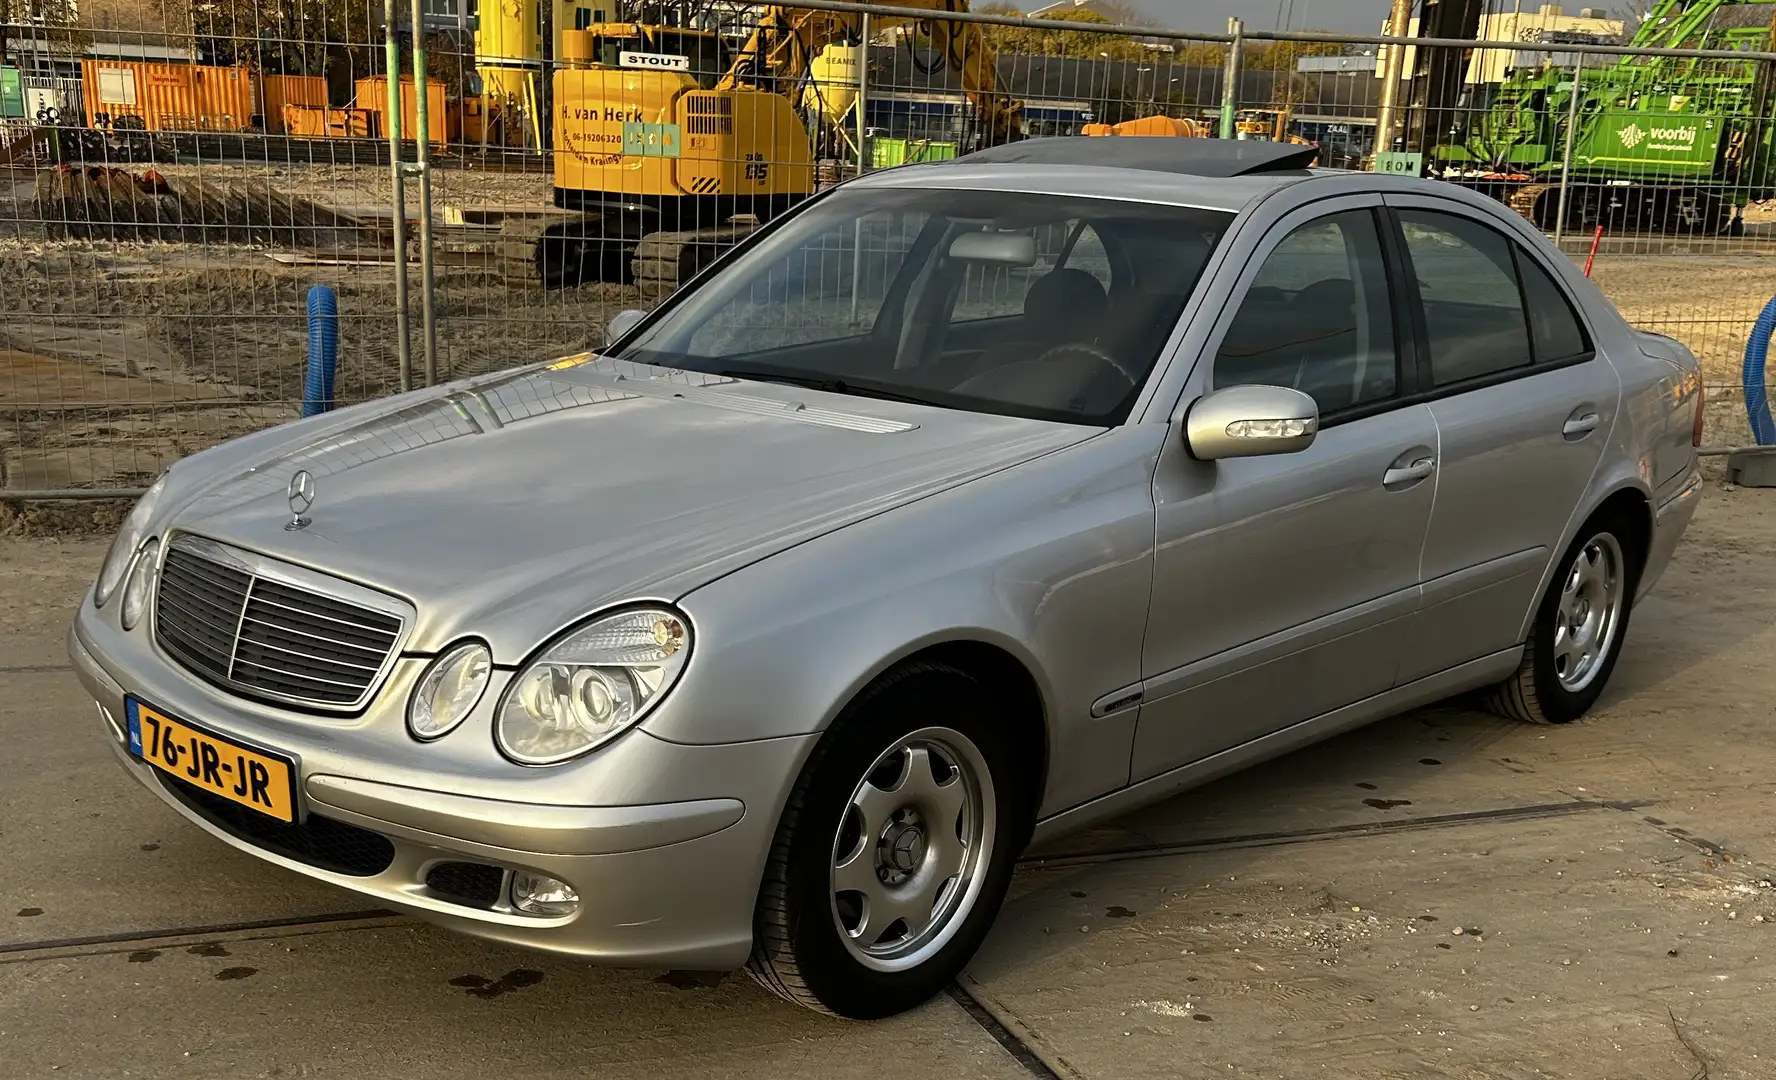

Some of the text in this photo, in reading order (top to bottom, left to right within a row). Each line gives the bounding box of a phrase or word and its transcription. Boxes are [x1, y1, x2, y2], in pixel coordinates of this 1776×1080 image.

[628, 55, 682, 67] STOUT
[575, 108, 598, 120] van
[604, 107, 644, 123] Herk
[1650, 126, 1697, 145] voorbij
[131, 731, 142, 747] NL
[145, 716, 273, 808] 76-JR-JR
